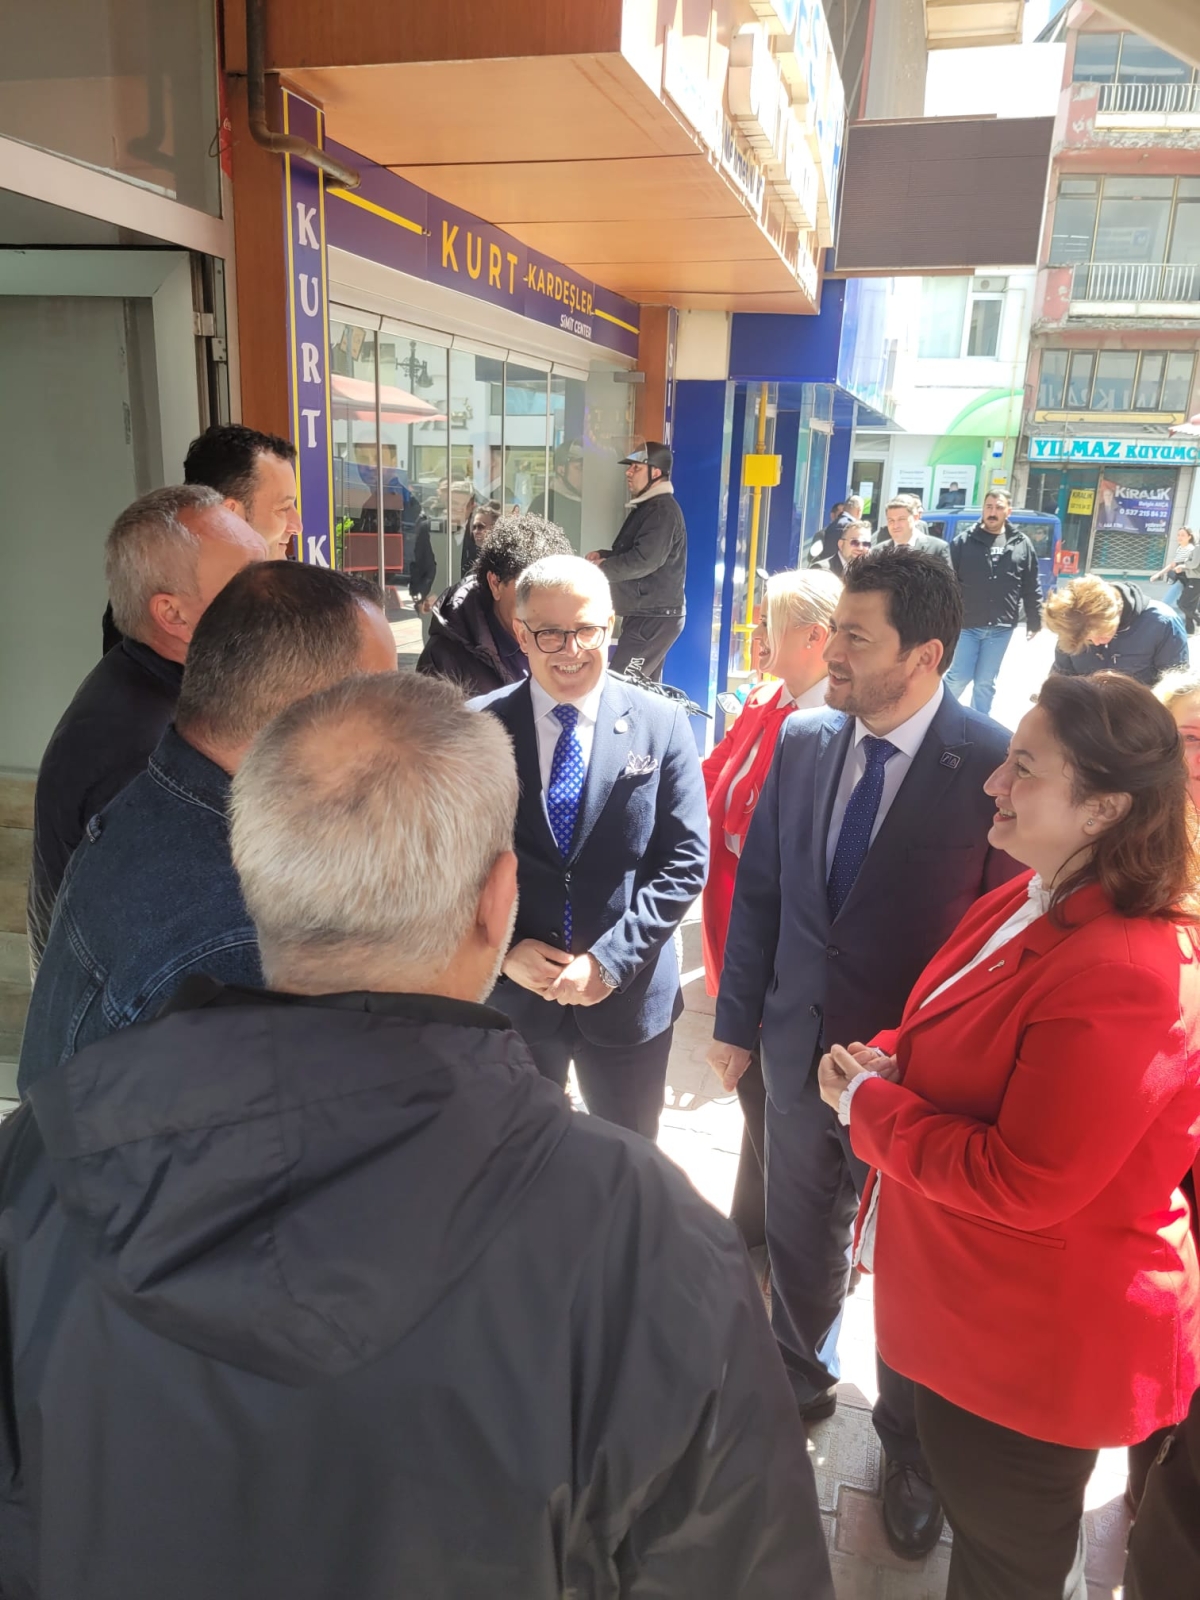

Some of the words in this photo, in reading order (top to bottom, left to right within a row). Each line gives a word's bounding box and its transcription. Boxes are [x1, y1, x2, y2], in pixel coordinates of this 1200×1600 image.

[441, 220, 518, 295] KURT
[528, 262, 593, 316] KARDEŞLER
[574, 320, 592, 339] CENTER
[1035, 440, 1121, 458] YILMAZ
